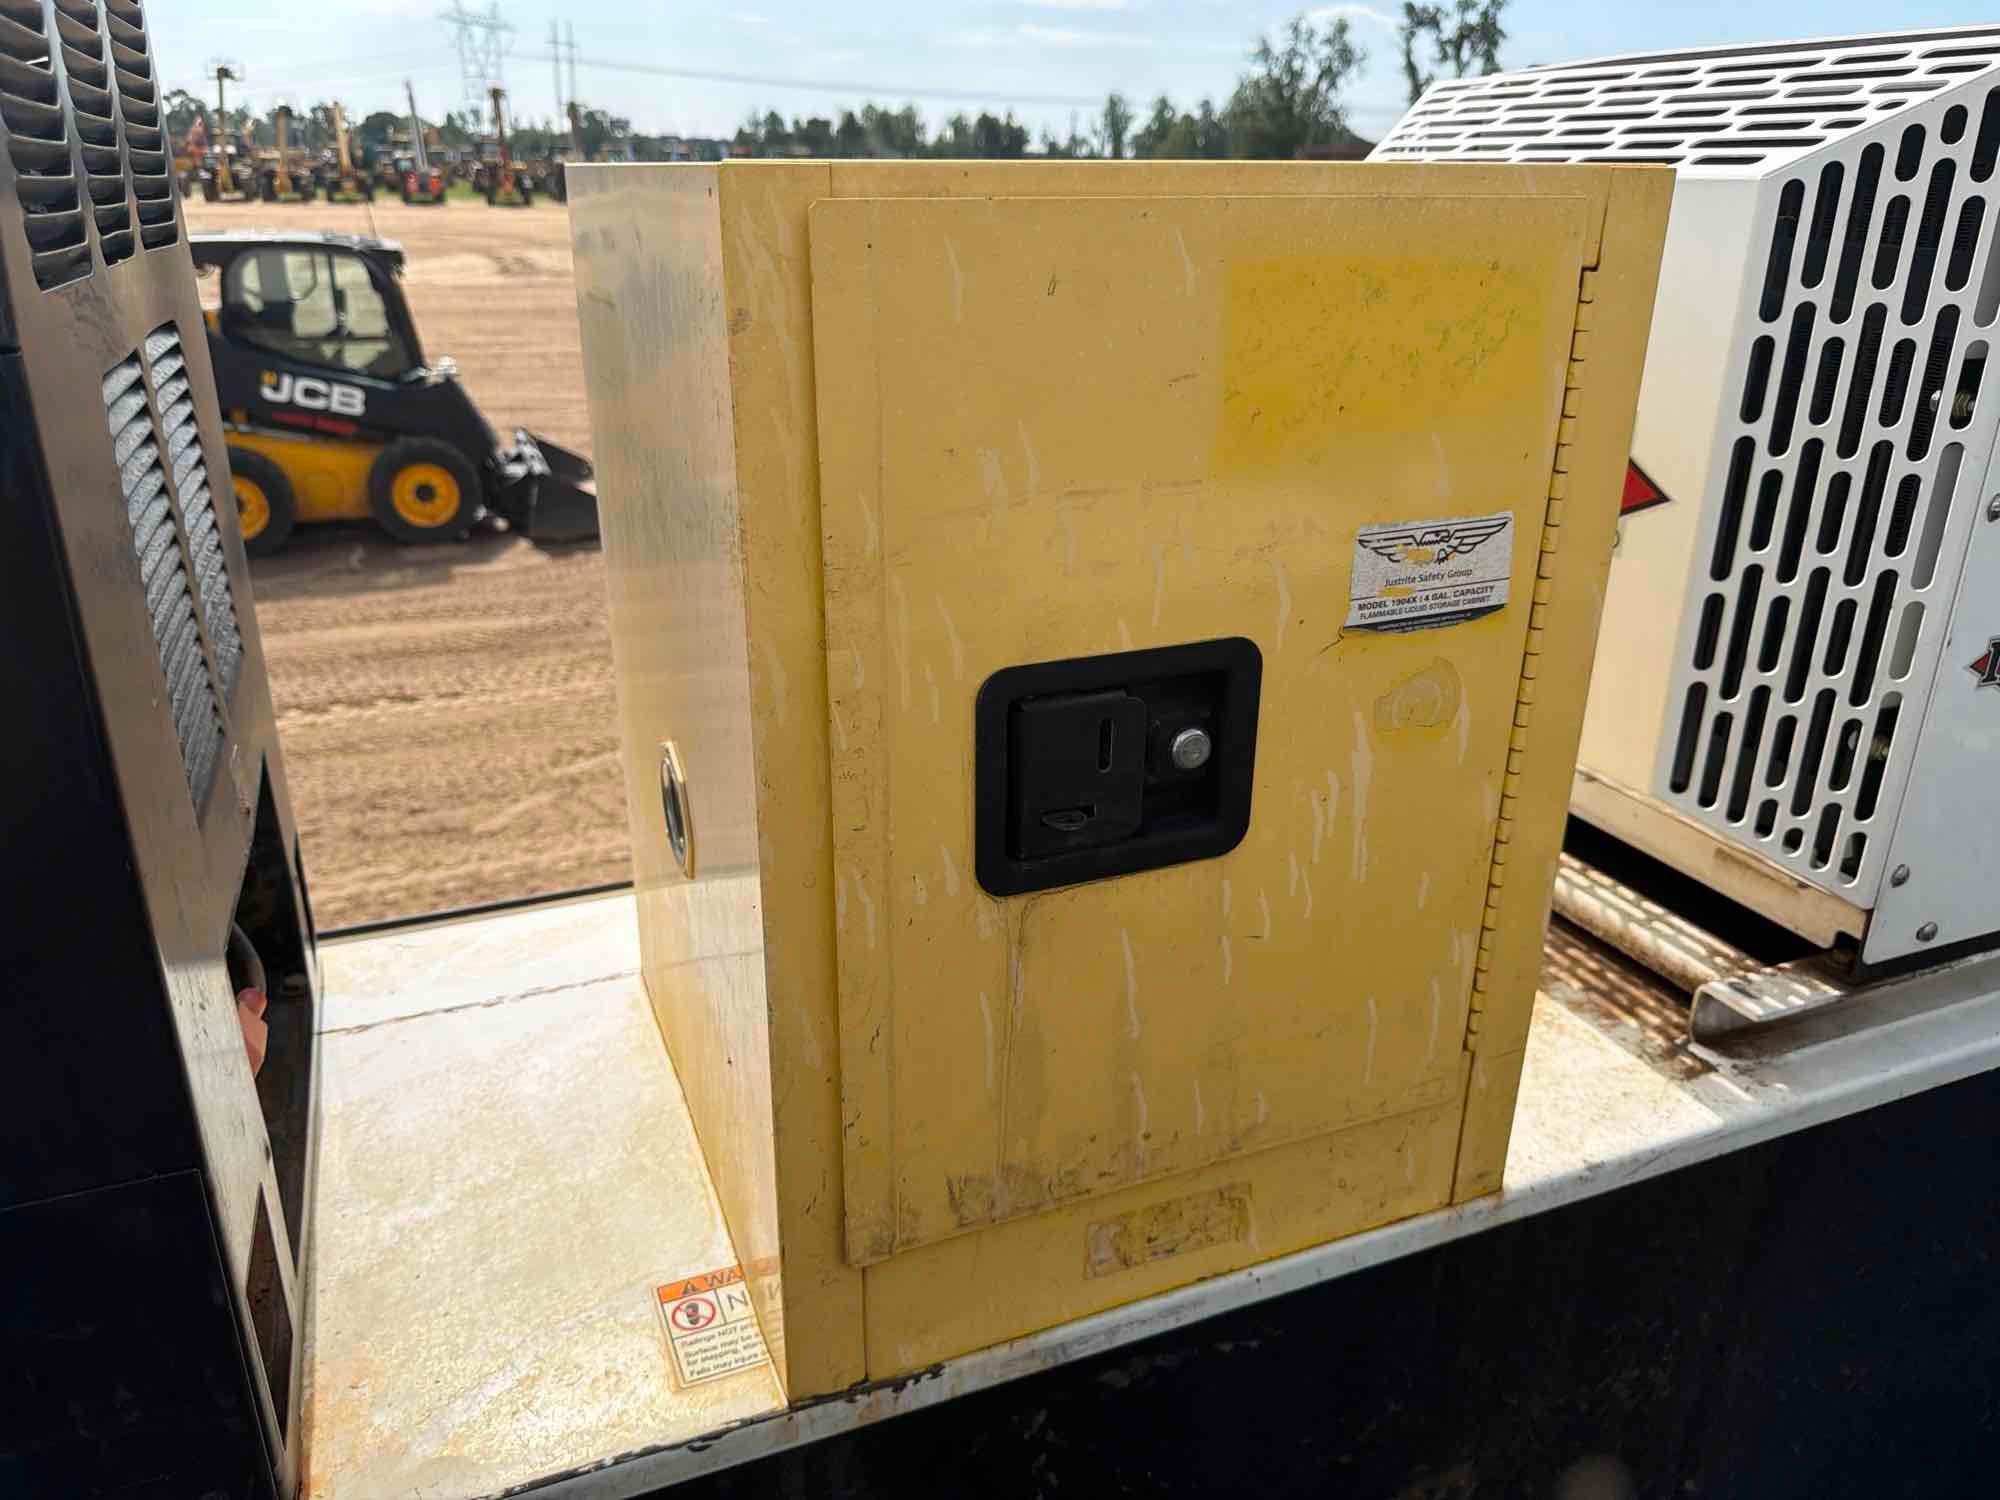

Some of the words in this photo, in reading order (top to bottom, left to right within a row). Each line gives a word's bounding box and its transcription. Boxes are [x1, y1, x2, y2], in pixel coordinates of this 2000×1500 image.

[261, 373, 366, 417] JCB
[1384, 573, 1416, 587] Justrite
[1417, 570, 1446, 583] Safety
[1447, 568, 1473, 578] Group
[1358, 600, 1388, 611] MODEL
[1453, 584, 1496, 598] CAPACITY
[1359, 606, 1404, 620] FLAMMABLE
[1404, 603, 1428, 614] LIQUID
[1429, 599, 1460, 611] STORAGE
[1463, 595, 1491, 606] CABINET
